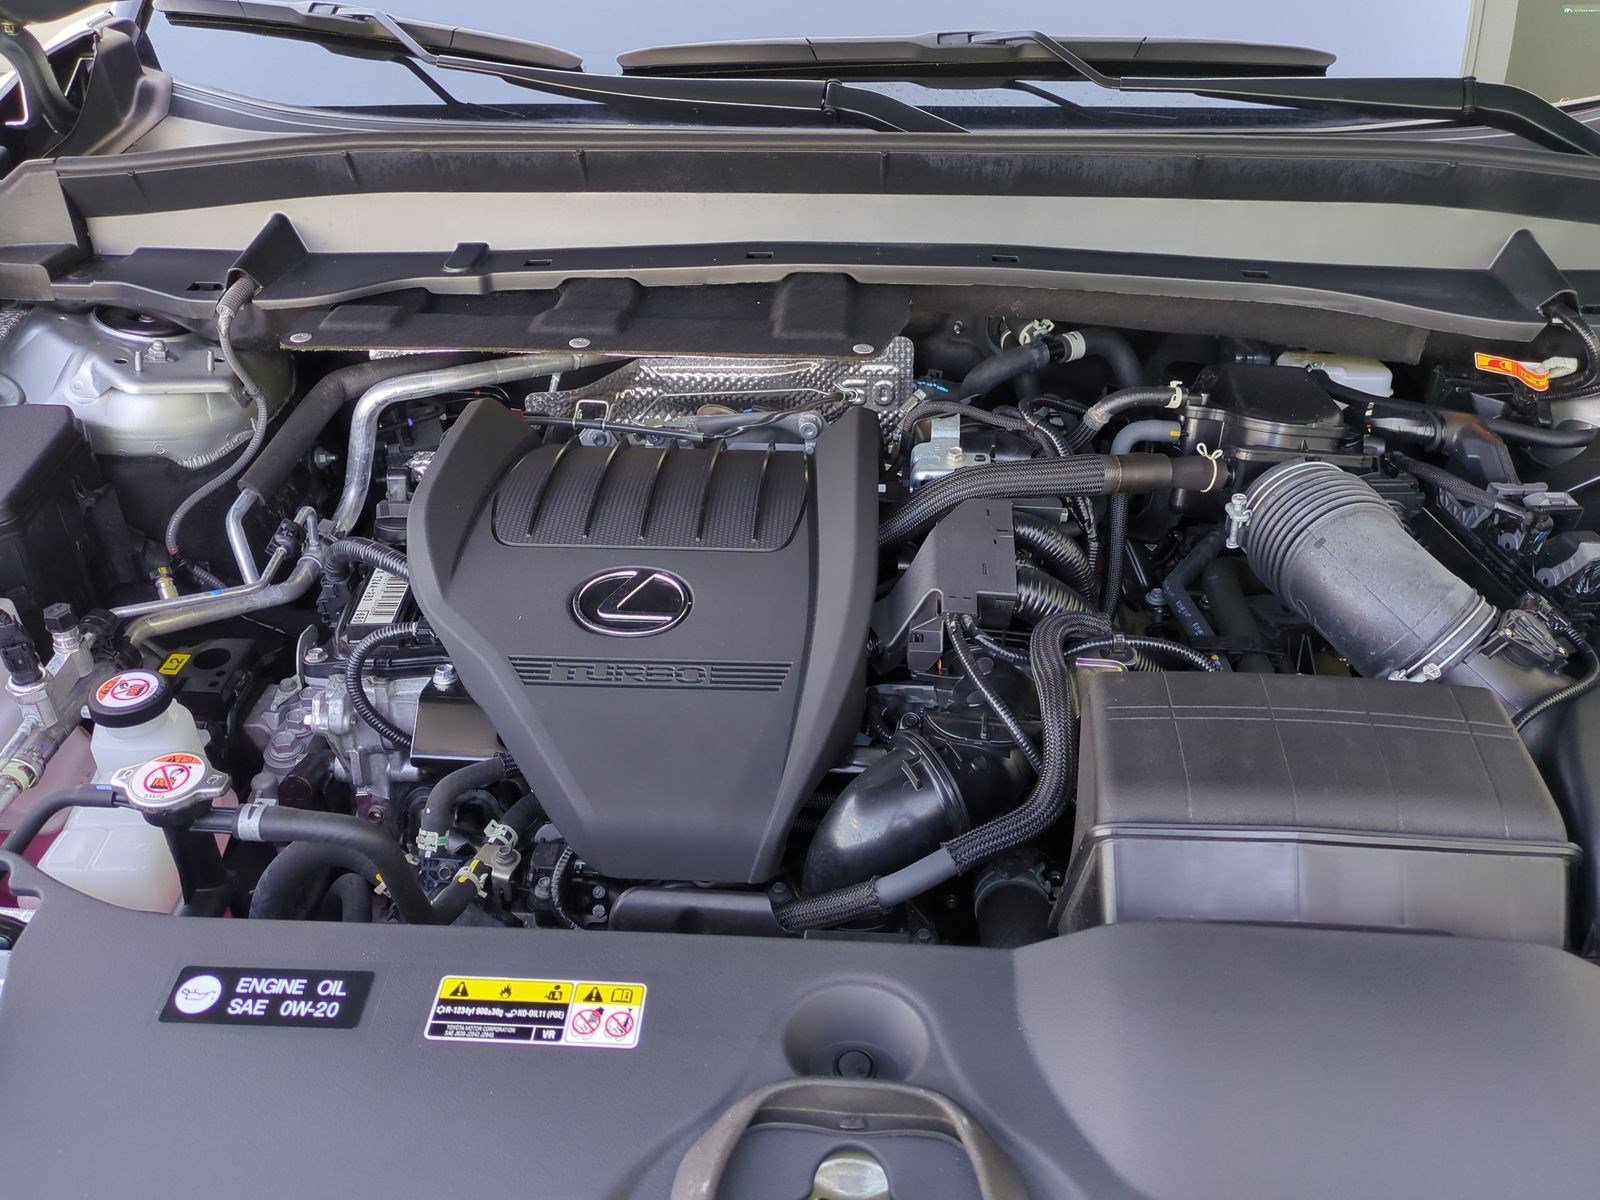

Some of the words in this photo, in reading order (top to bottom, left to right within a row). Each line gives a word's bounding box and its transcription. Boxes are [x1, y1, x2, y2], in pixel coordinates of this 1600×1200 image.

[163, 657, 184, 671] L2
[556, 661, 707, 684] TURBO
[235, 977, 308, 996] ENGINE
[316, 979, 347, 997] OIL
[226, 998, 269, 1016] SAE
[279, 1000, 340, 1018] 0W-20
[541, 1029, 556, 1040] VR
